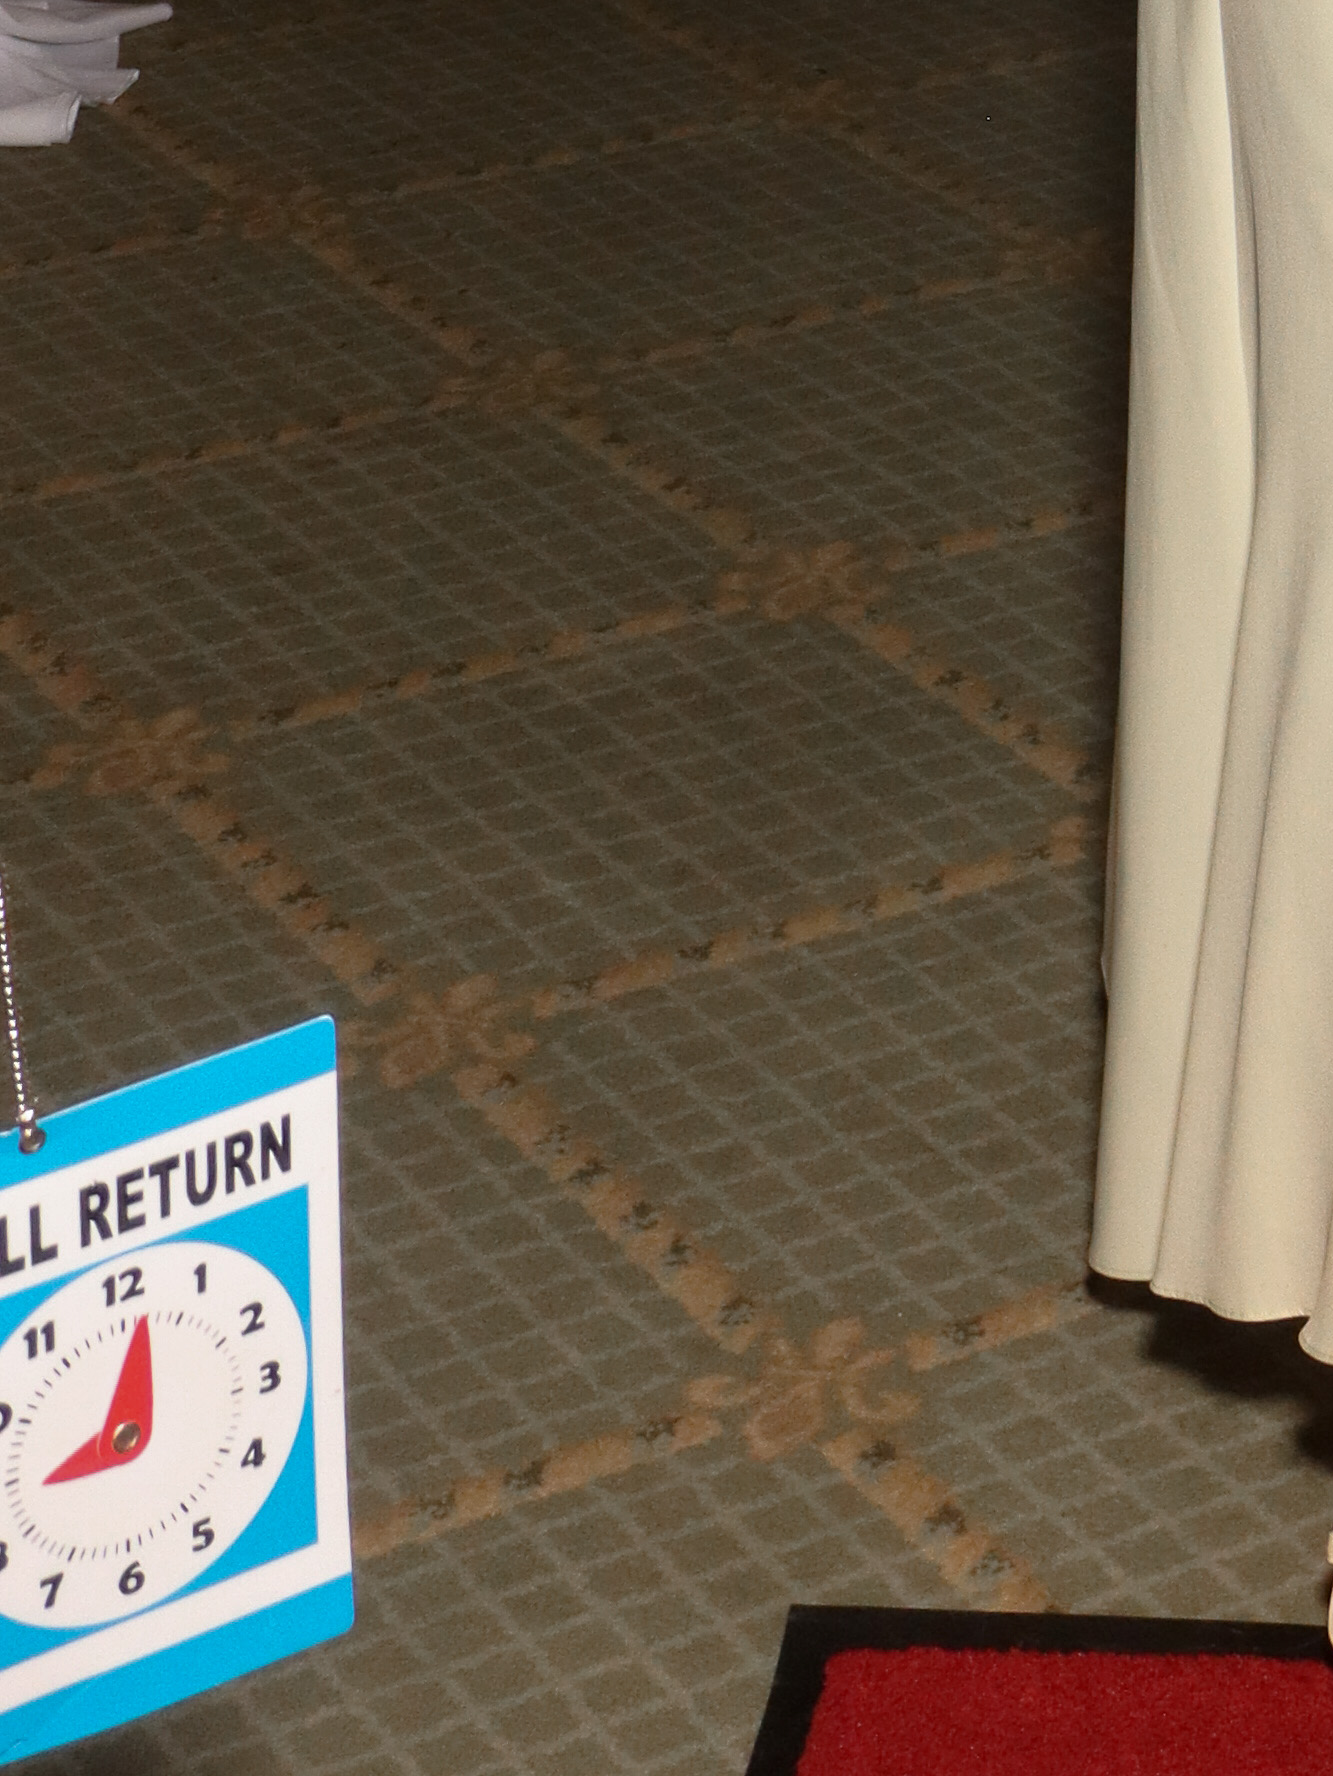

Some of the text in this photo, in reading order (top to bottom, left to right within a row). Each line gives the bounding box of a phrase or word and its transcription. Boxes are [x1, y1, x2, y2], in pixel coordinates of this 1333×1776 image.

[79, 1112, 292, 1249] RETURN
[102, 1266, 145, 1307] 12
[193, 1262, 207, 1294] 1
[241, 1302, 266, 1336] 2
[23, 1321, 56, 1360] 11
[258, 1360, 282, 1394] 3
[240, 1438, 267, 1468] 4
[191, 1517, 216, 1552] 5
[39, 1573, 64, 1609] 7
[117, 1561, 146, 1596] 6
